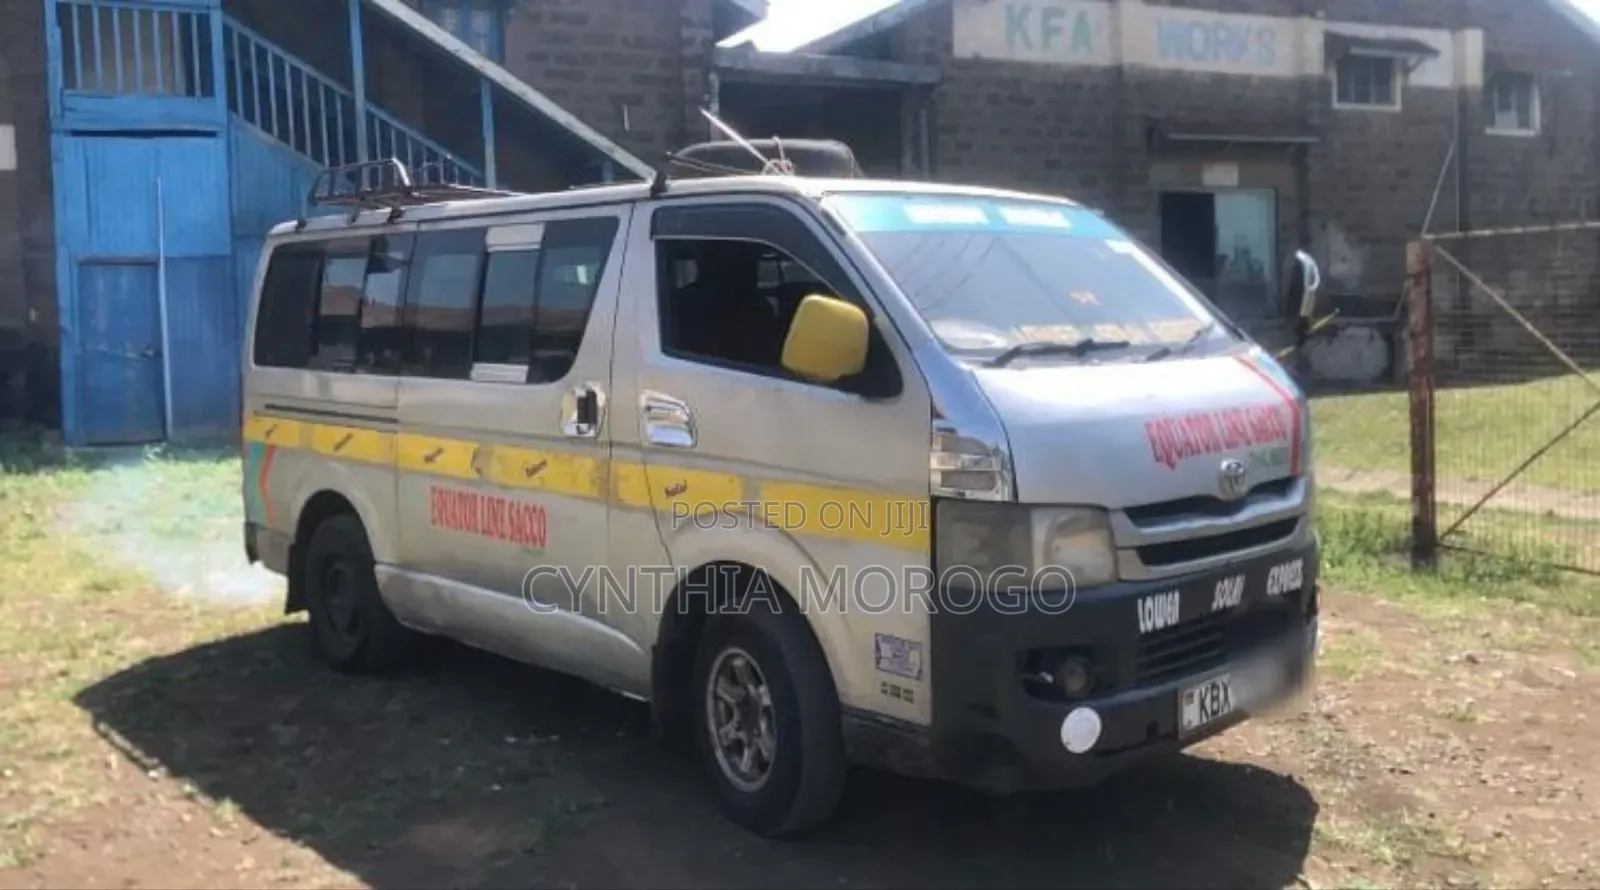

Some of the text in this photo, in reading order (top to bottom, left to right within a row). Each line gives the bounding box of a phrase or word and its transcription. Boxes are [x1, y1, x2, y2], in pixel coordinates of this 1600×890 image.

[1004, 4, 1096, 53] KFA
[508, 500, 547, 549] SACCO
[1199, 676, 1232, 723] KBX
